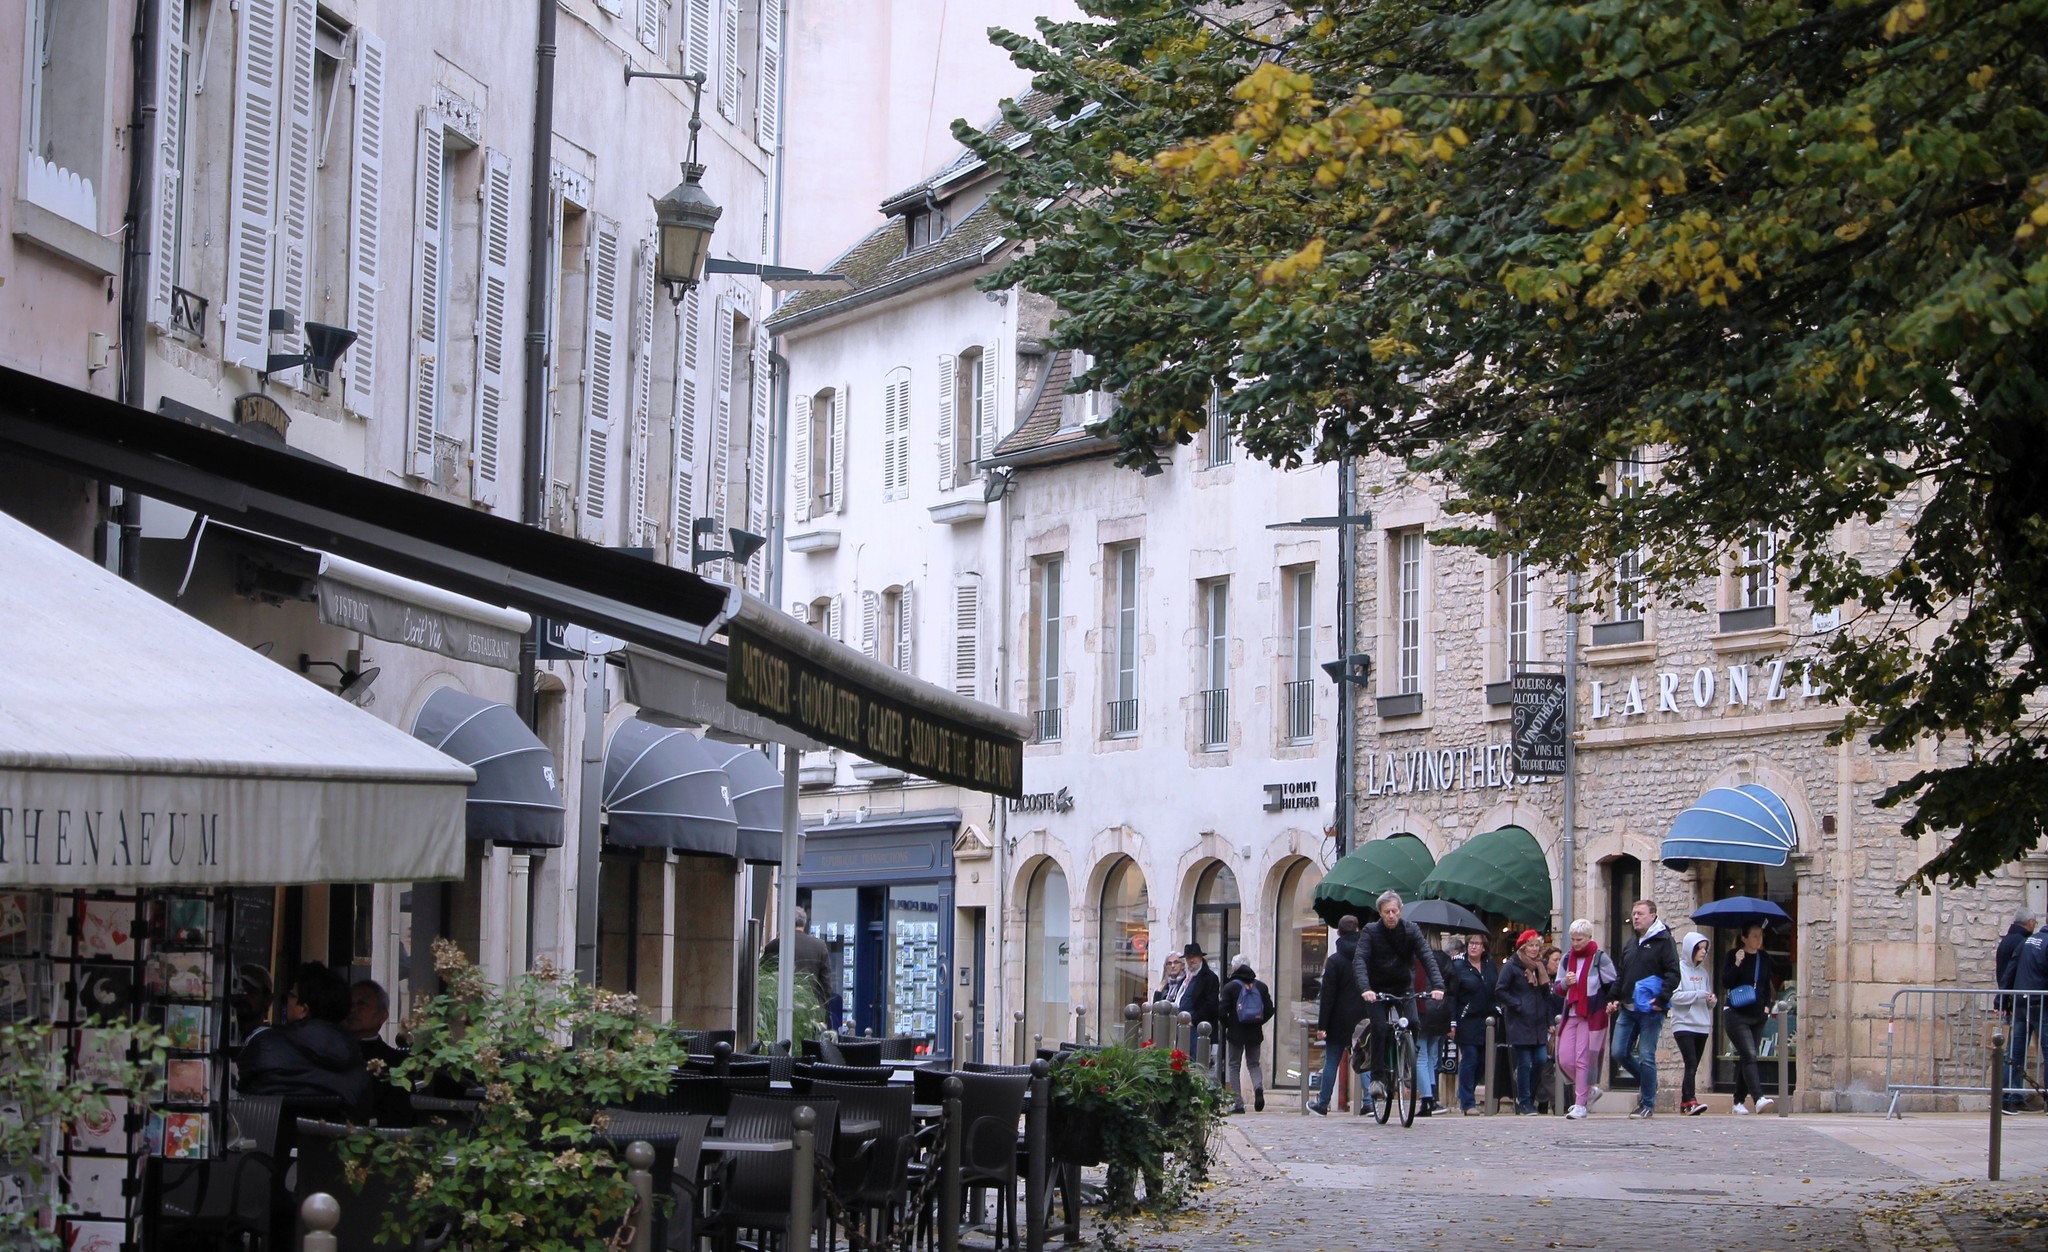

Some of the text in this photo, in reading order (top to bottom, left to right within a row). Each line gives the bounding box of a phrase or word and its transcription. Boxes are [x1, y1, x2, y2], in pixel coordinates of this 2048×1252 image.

[241, 396, 288, 439] RESTAURANT
[467, 633, 510, 660] RESTAURANT
[1513, 678, 1545, 690] LIQUEURS
[1513, 693, 1545, 705] ALCOOLS
[867, 701, 903, 758] GLACIER
[910, 718, 938, 768] SALON
[938, 727, 951, 774] DE
[974, 738, 991, 784] BAR
[1534, 744, 1565, 757] VINS DE
[1368, 742, 1546, 795] LA VINOTHEQ
[1283, 781, 1317, 794] TOMMY
[1008, 793, 1056, 812] LACOSTE
[1281, 796, 1319, 810] HILFIGER
